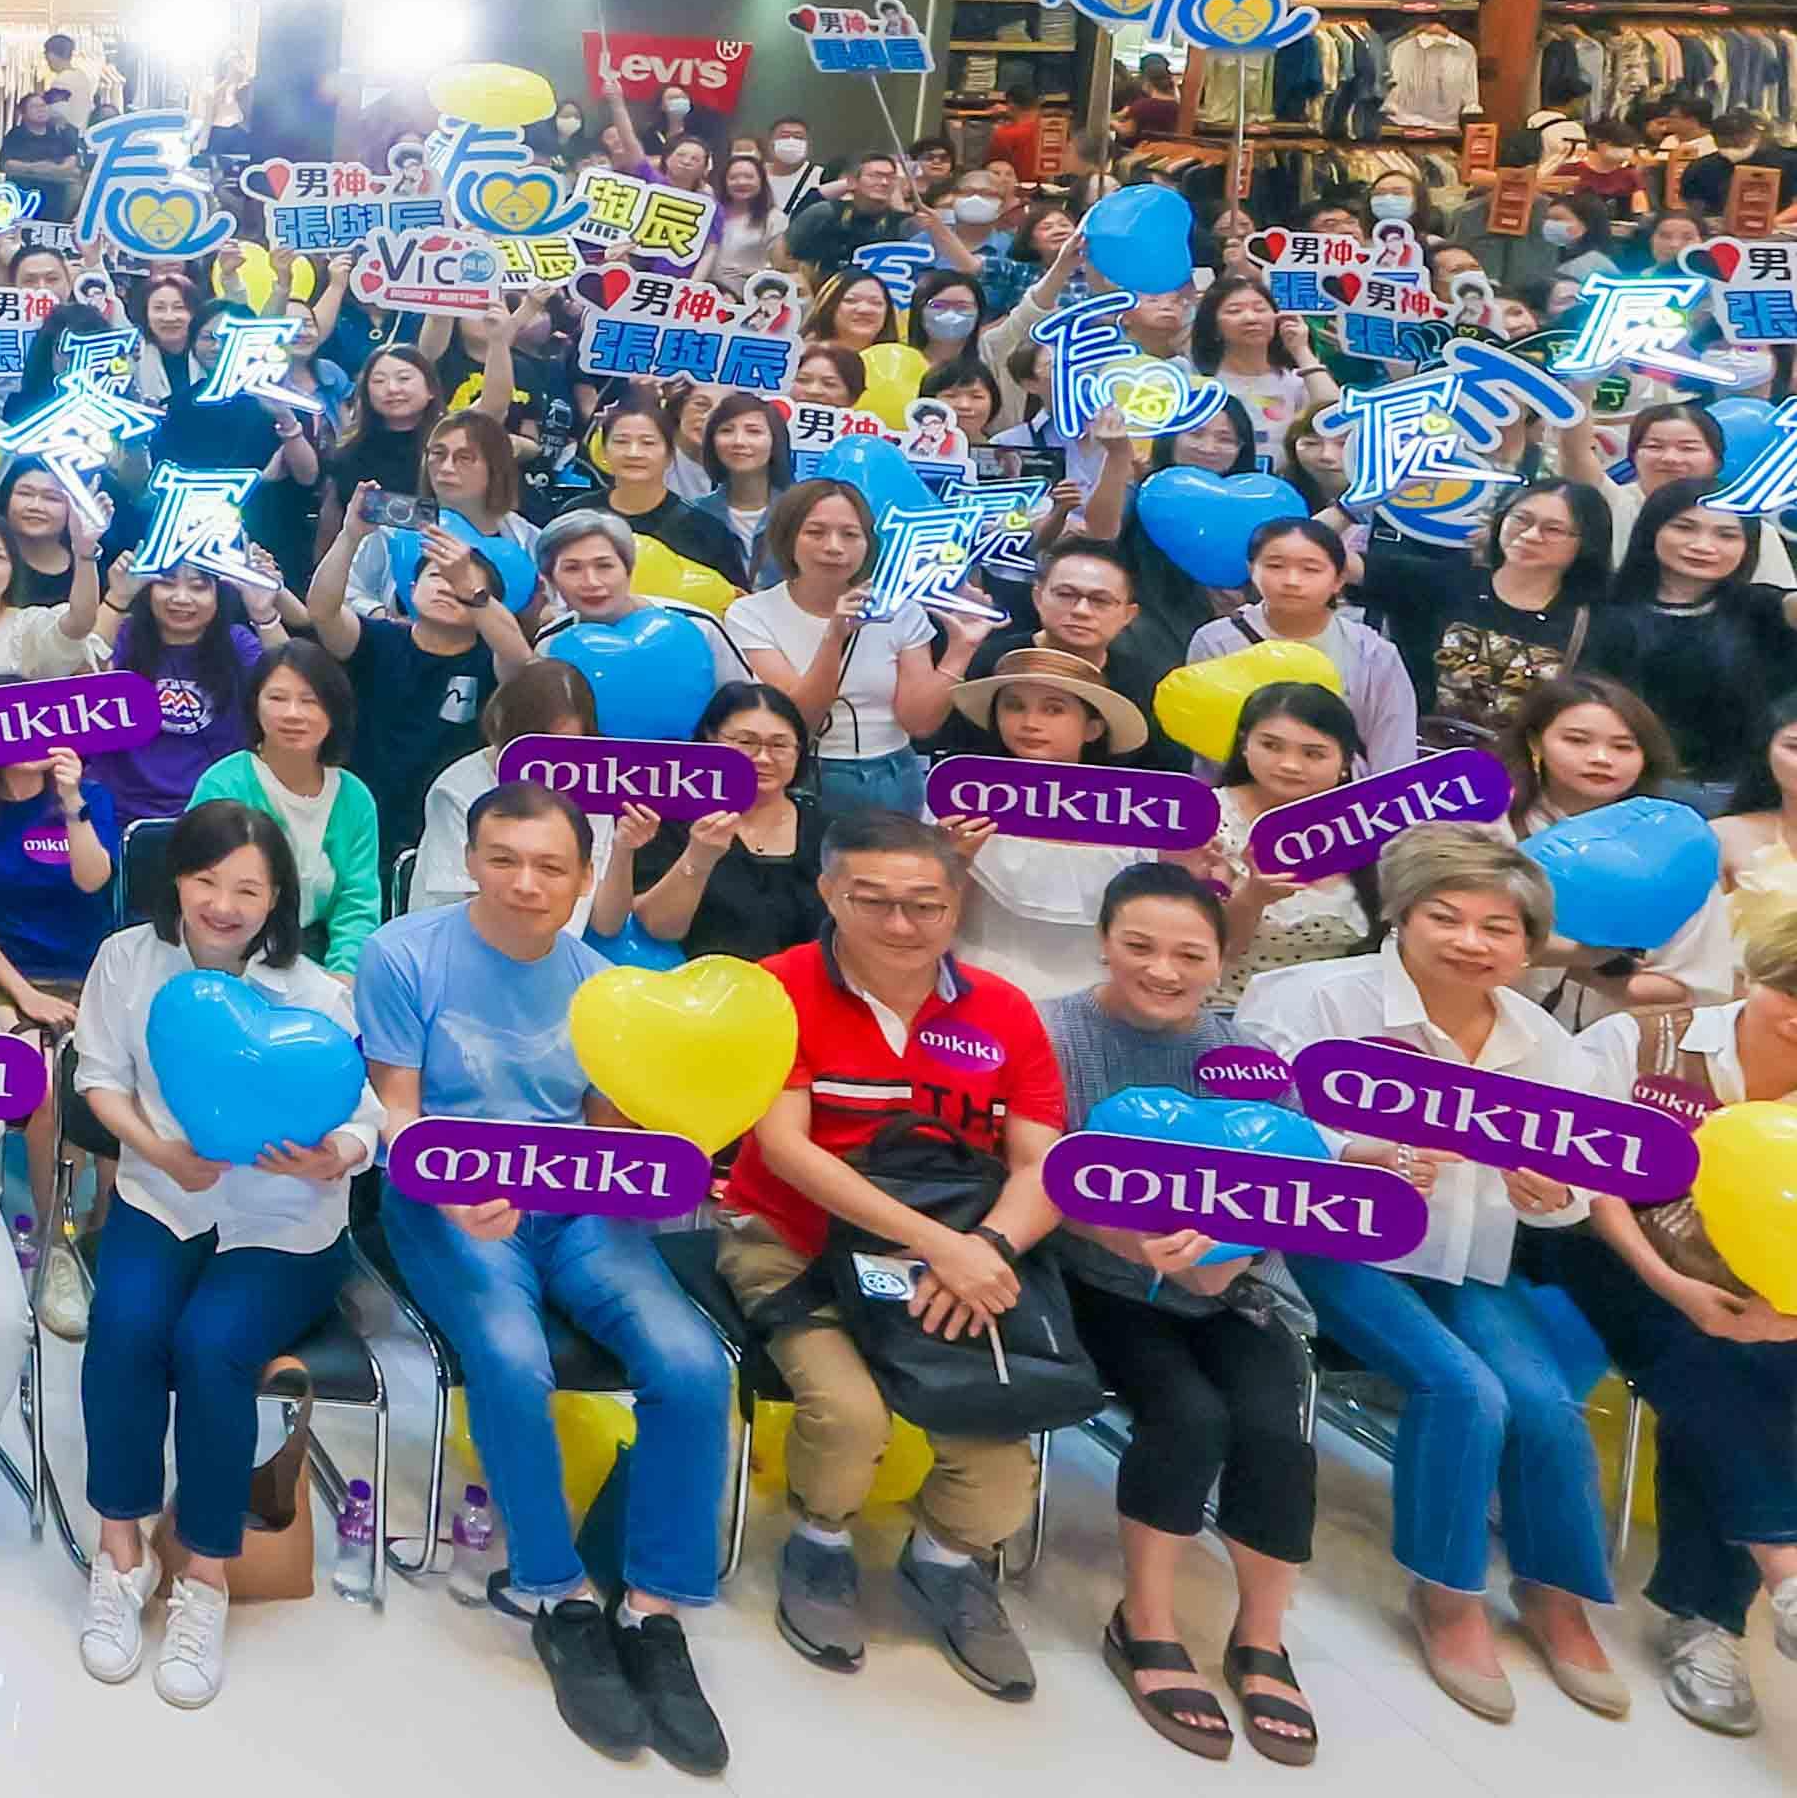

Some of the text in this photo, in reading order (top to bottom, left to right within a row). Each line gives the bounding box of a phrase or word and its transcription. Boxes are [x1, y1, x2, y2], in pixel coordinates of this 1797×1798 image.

[821, 12, 868, 35] 男神
[811, 38, 925, 69] 張與辰
[294, 167, 370, 198] 男神
[584, 176, 705, 258] 與辰
[1291, 235, 1354, 266] 男神
[632, 277, 716, 325] 男神
[1365, 281, 1429, 316] 男神
[587, 318, 791, 389] 張與辰
[797, 406, 879, 444] 男神
[518, 754, 727, 804] mikiki
[949, 776, 1189, 831] mikiki
[1272, 770, 1486, 866] mikiki
[919, 1030, 1000, 1063] mikiki
[1198, 1063, 1287, 1081] mikiki
[1322, 1067, 1651, 1179] mikiki
[415, 1143, 671, 1199] mikiki
[1073, 1161, 1384, 1239] mikiki
